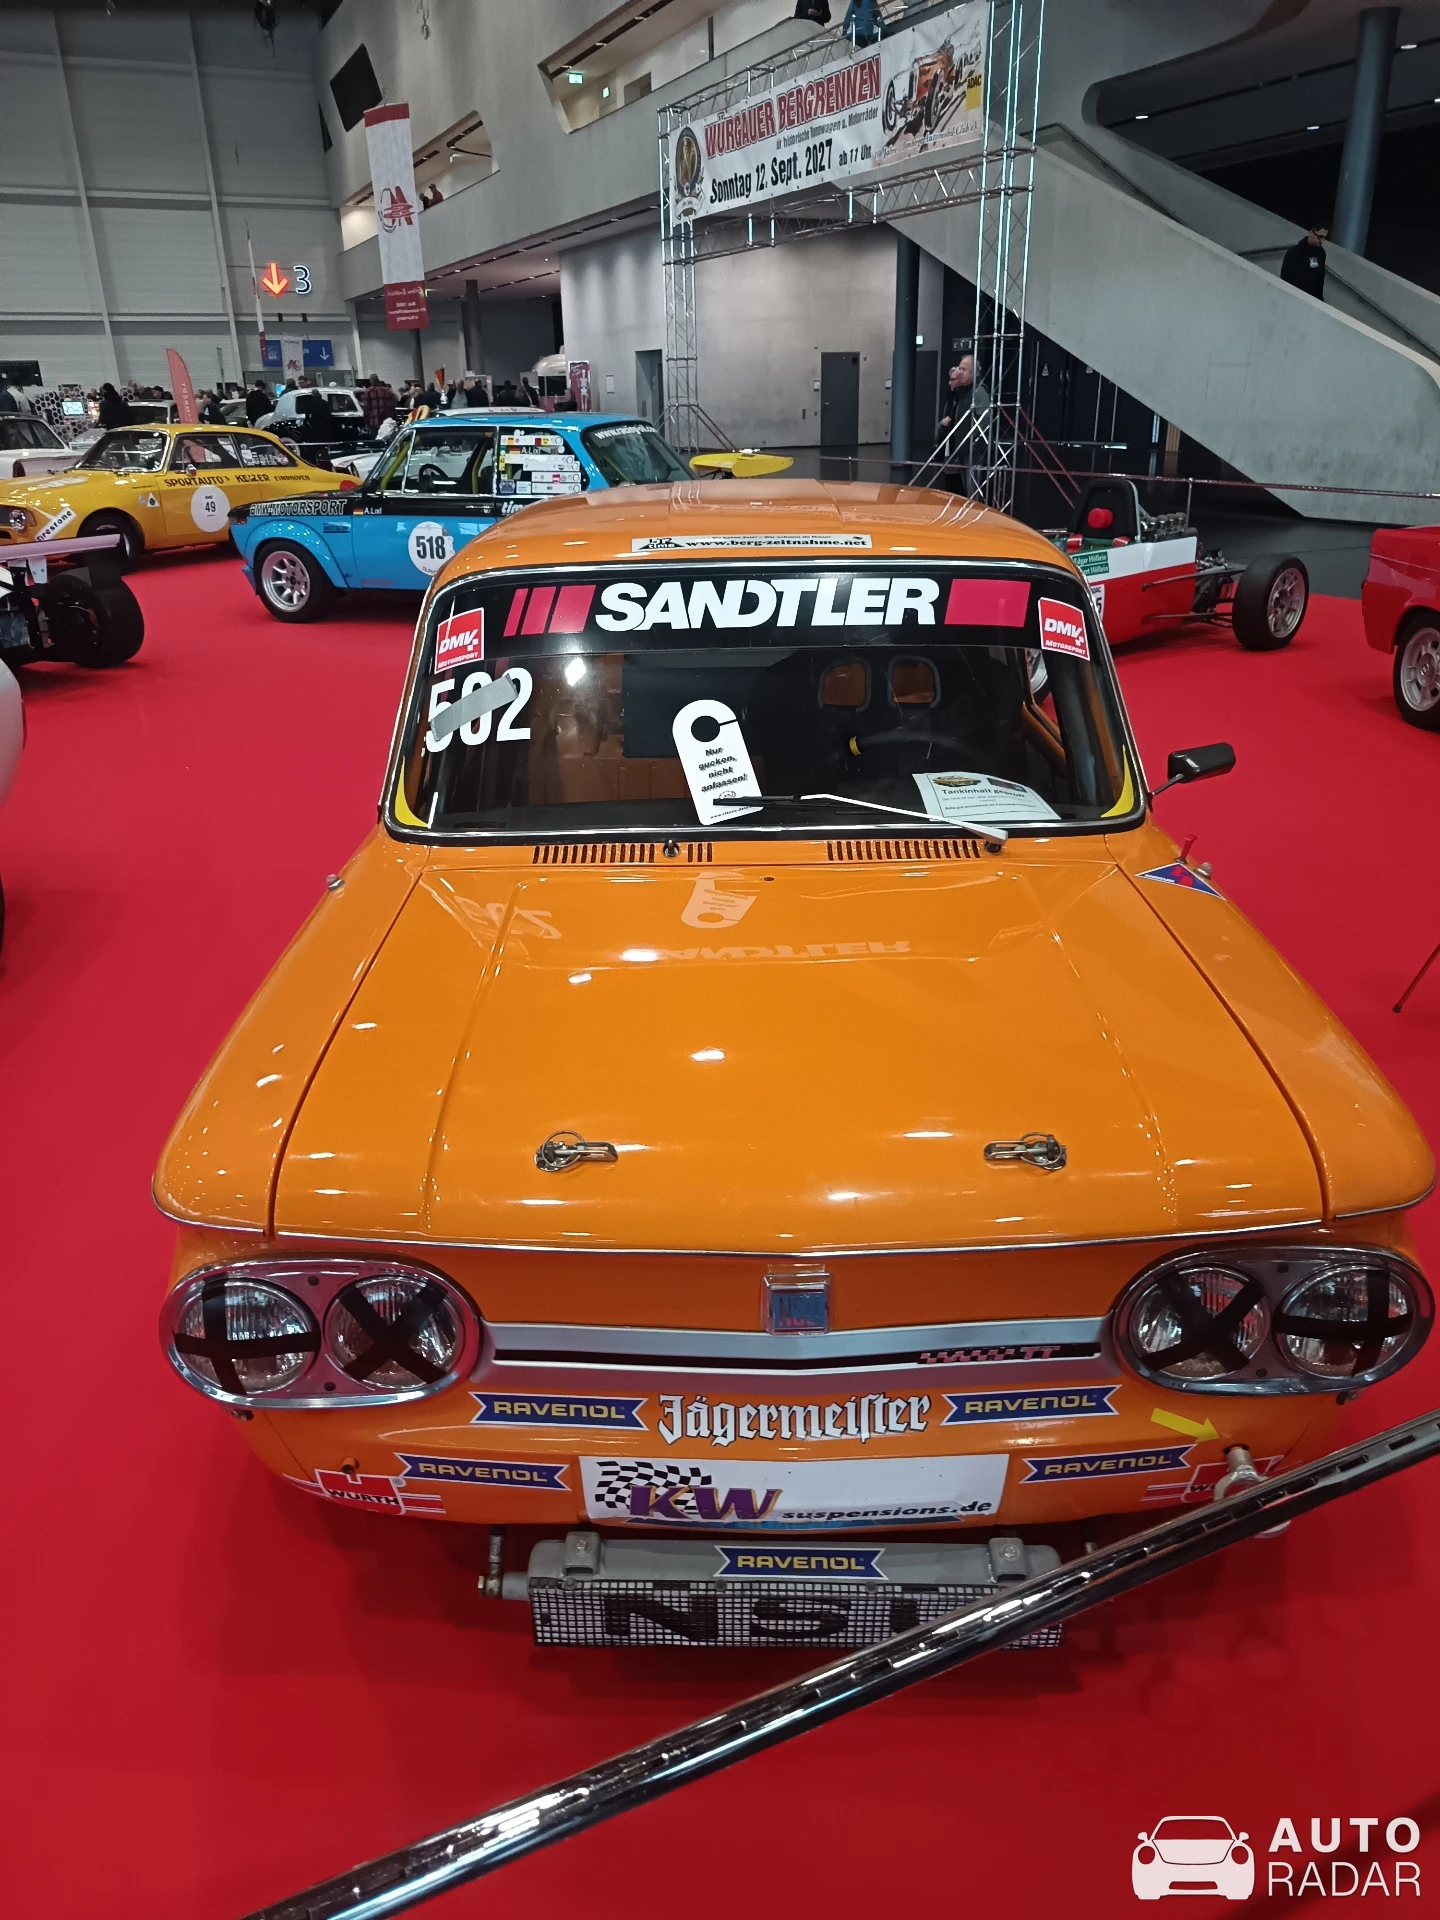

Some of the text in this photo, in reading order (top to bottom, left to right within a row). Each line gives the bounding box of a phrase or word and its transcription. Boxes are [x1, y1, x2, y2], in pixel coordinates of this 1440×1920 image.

[966, 74, 982, 89] ADAC
[704, 53, 882, 160] WÜRGAUER BERGRENNEN
[710, 138, 872, 204] Sonntag 12. Sept. 2027 ab 11 Uhr
[293, 265, 312, 295] 3
[205, 501, 216, 512] 49
[501, 500, 528, 516] tim
[416, 535, 446, 560] 518
[686, 537, 867, 548] www.berg-zeitnahme.net
[594, 577, 941, 632] SANDTLER
[1044, 617, 1083, 639] DMV
[439, 629, 479, 654] DMV
[705, 747, 724, 757] Nur
[698, 756, 738, 771] gucken,
[708, 766, 734, 779] nicht
[701, 773, 748, 792] anfassen!
[1020, 1345, 1061, 1360] TT
[493, 1401, 626, 1420] RAVENOL
[964, 1394, 1096, 1414] RAVENOL
[418, 1462, 548, 1482] RAVENOL
[1044, 1453, 1173, 1474] RAVENOL
[629, 1485, 783, 1520] KW
[782, 1500, 992, 1521] suspensions.de
[737, 1554, 866, 1571] RAVENOL
